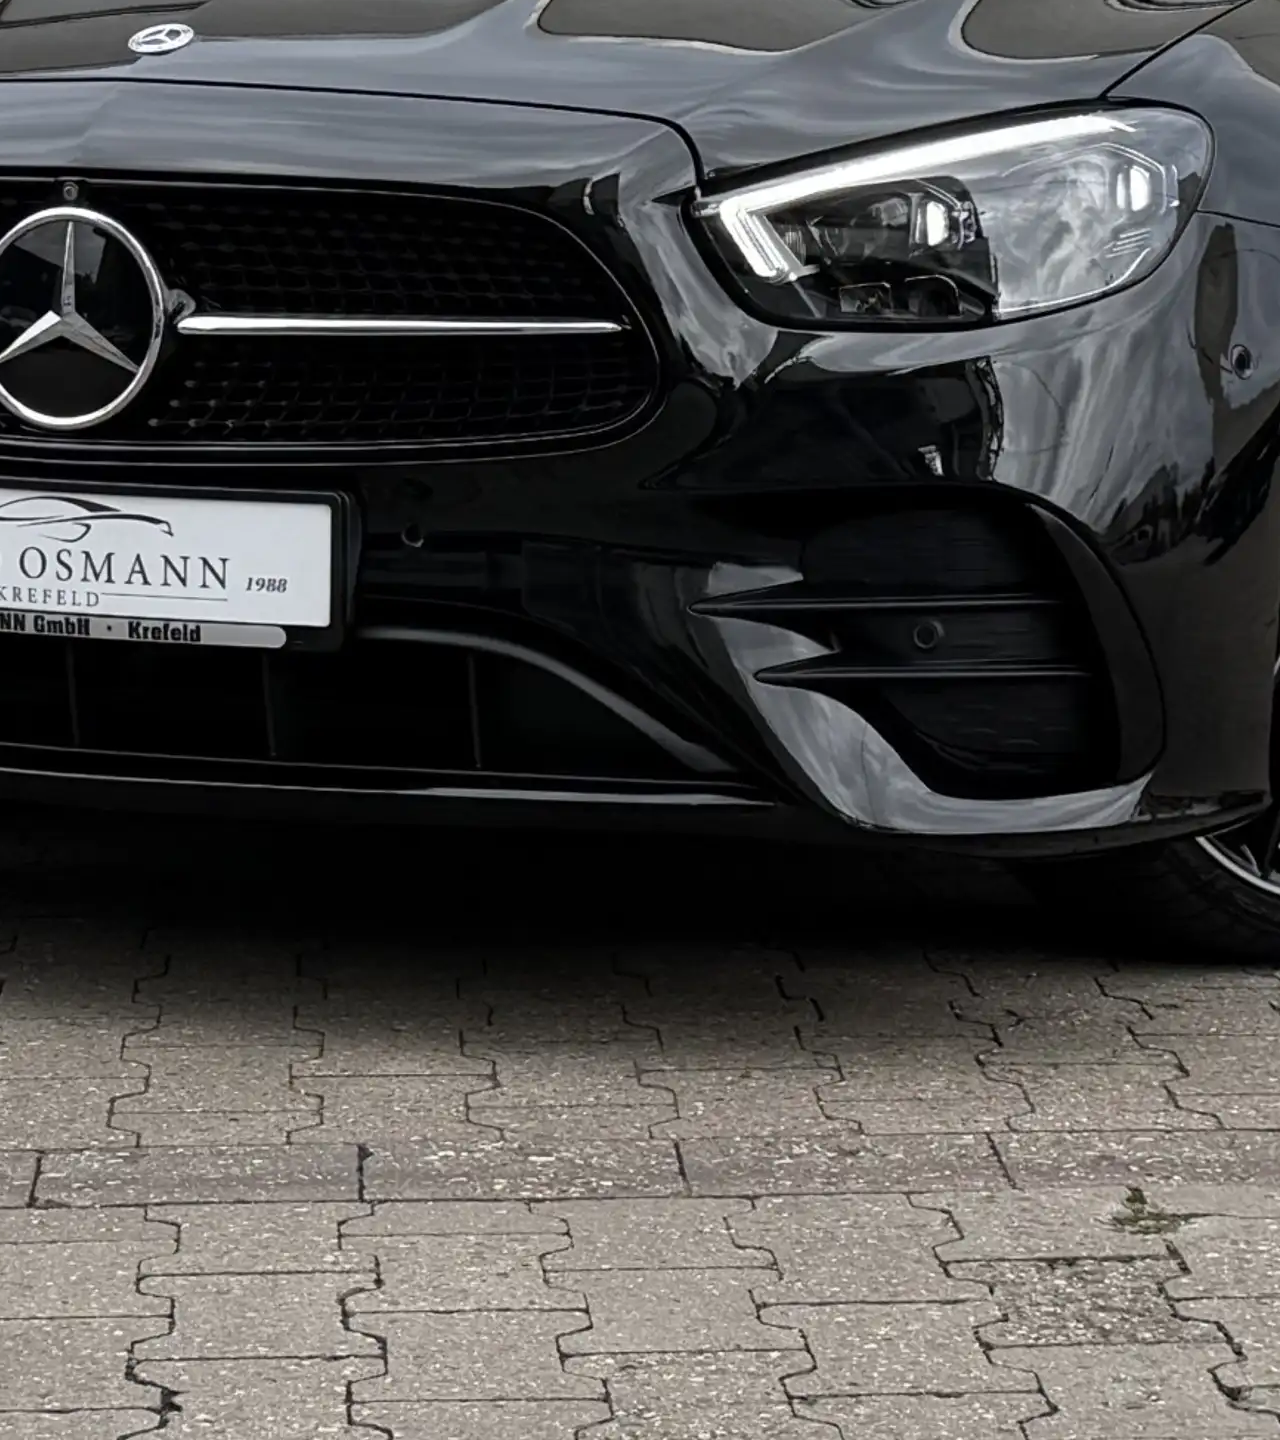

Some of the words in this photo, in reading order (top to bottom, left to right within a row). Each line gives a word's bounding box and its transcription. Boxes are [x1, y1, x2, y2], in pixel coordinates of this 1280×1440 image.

[19, 546, 230, 589] OSMANN
[245, 576, 288, 593] 1988
[33, 616, 91, 636] GmbH
[128, 622, 201, 642] Krefeld
